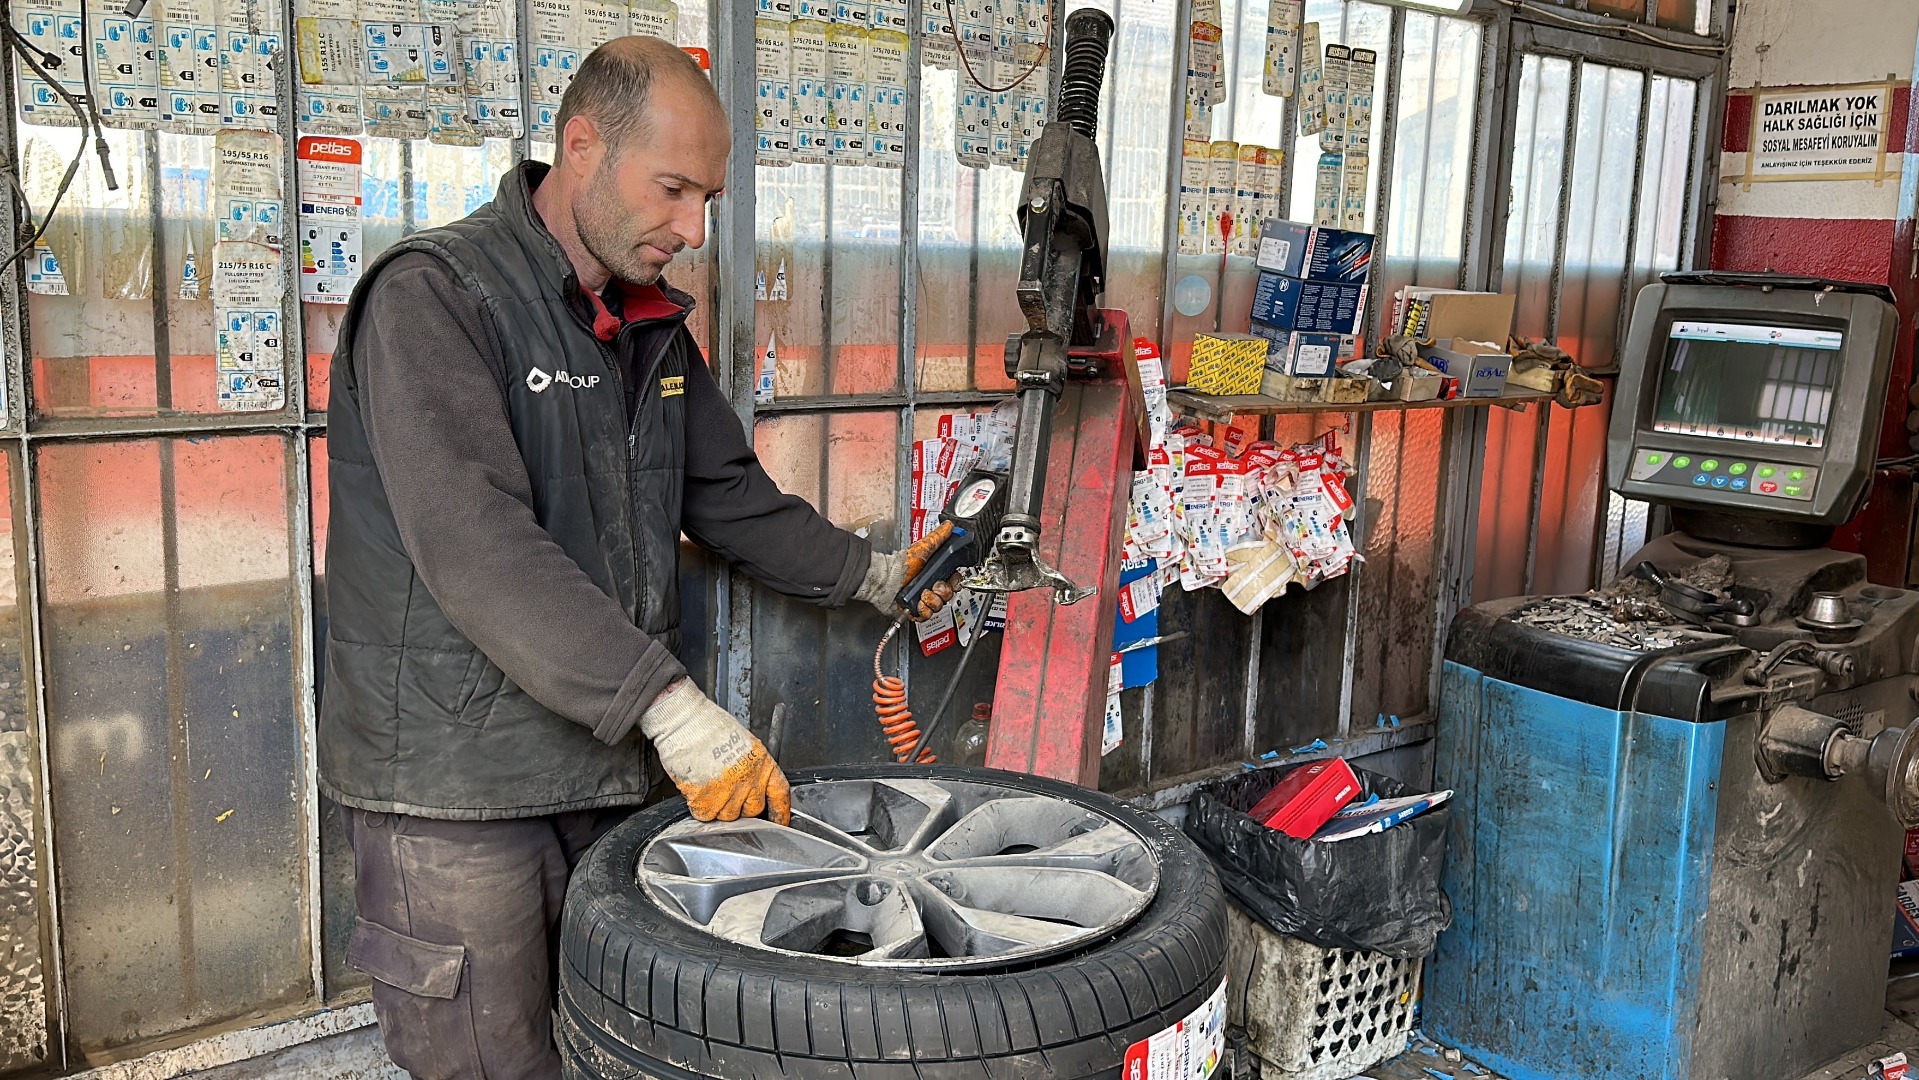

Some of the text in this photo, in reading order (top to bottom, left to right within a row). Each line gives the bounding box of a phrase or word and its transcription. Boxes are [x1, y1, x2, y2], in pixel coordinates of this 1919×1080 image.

[584, 9, 607, 17] 195/65
[628, 12, 650, 21] 195/70
[651, 16, 663, 24] R15
[1764, 95, 1878, 116] DARILMAK YOK
[1763, 113, 1877, 132] HALK SAĞLIĞI İÇİN
[309, 141, 352, 156] petlas
[1762, 133, 1877, 153] SOSYAL MESAFEYİ KORUYALIM
[222, 150, 251, 159] 195/55
[1761, 157, 1873, 169] ANLAYIŞINIZ İÇİN TEŞEKKÜR EDERİZ
[315, 206, 345, 215] ENERG
[1307, 231, 1316, 255] BOSCH
[218, 261, 247, 270] 215/75
[1358, 288, 1366, 311] BOSCH
[1194, 446, 1220, 459] petlas
[1249, 454, 1273, 465] petlas
[939, 447, 952, 476] petlas
[1189, 463, 1211, 473] petlas
[1326, 479, 1347, 504] petlas
[1121, 591, 1132, 616] petlas
[926, 633, 950, 651] petlas
